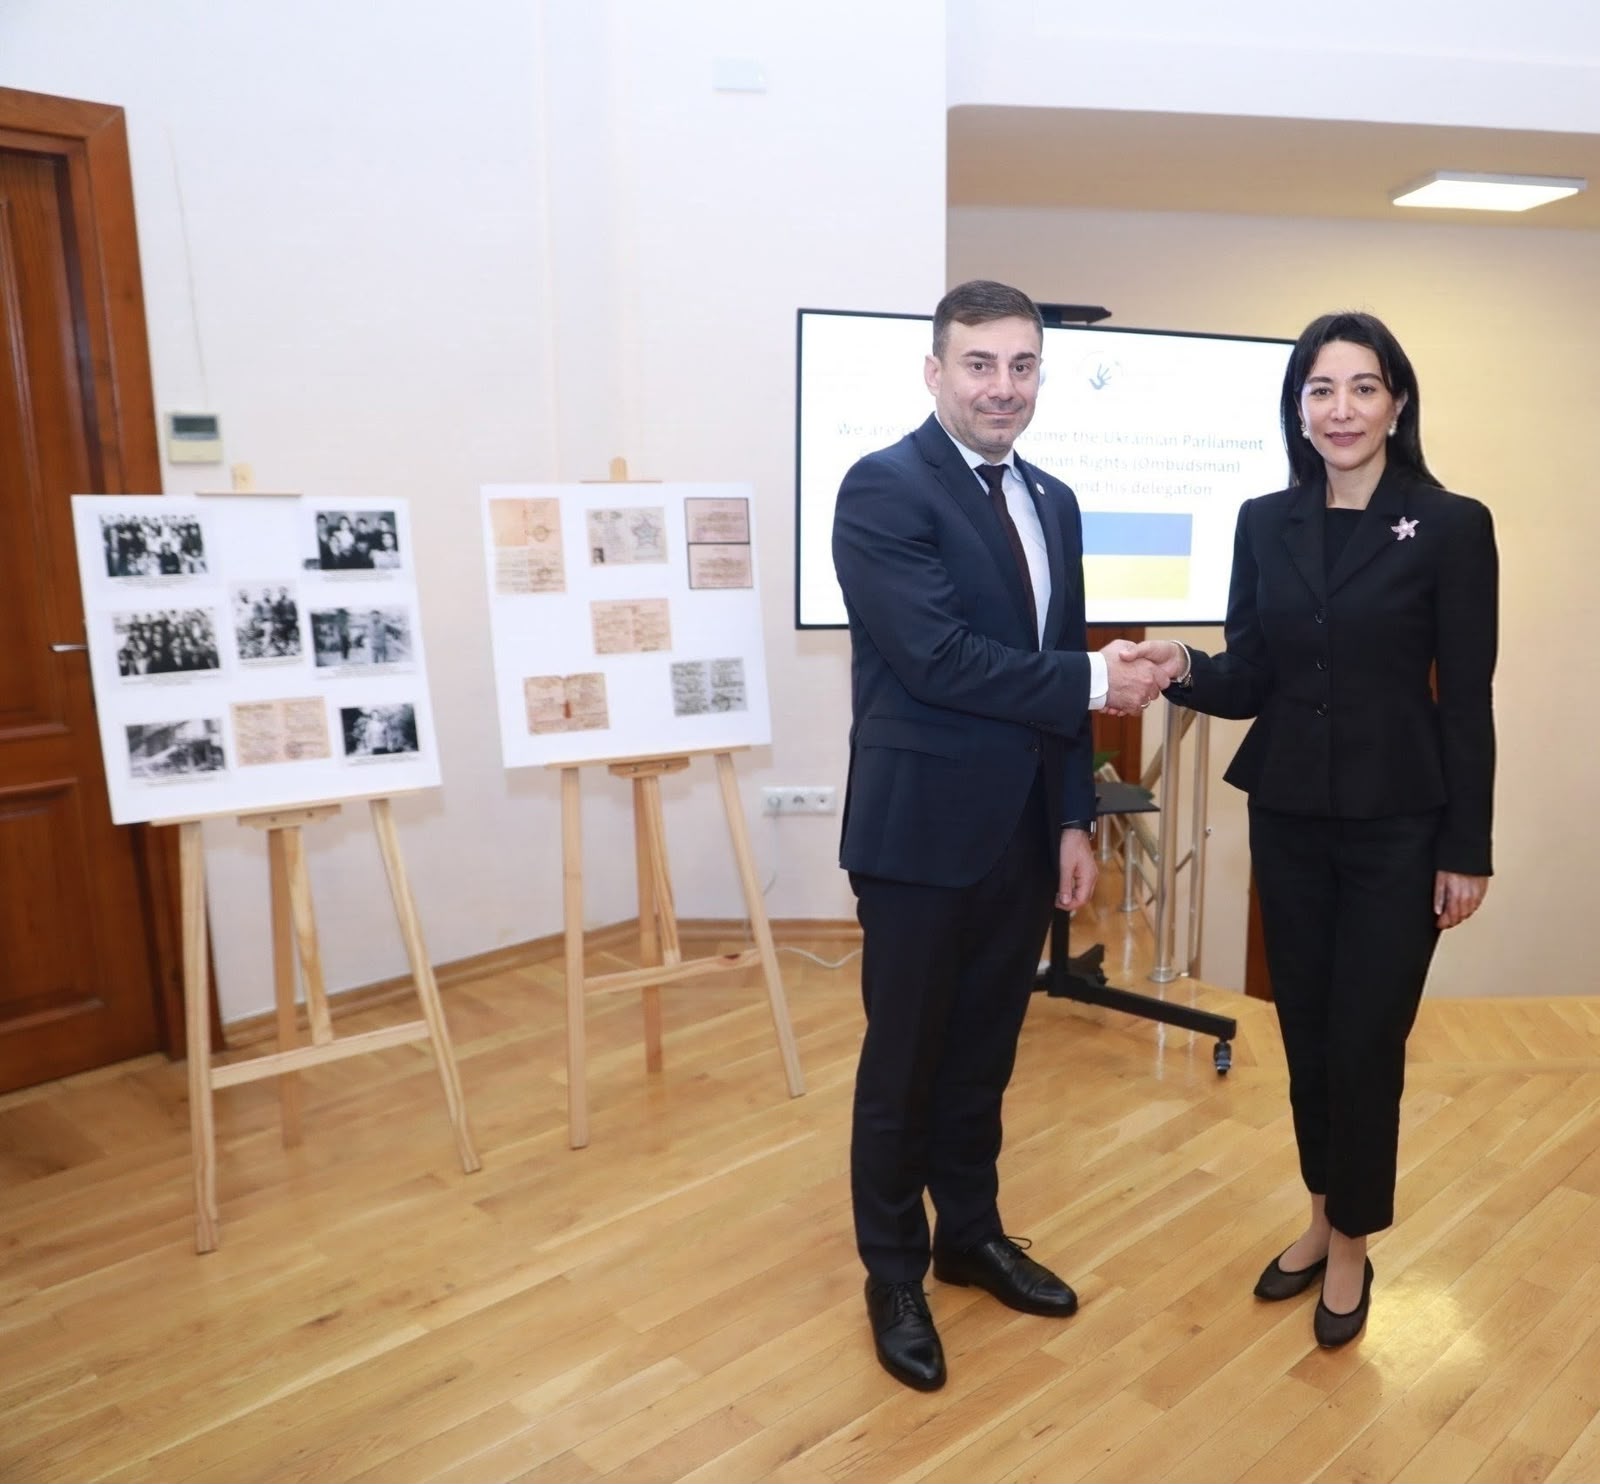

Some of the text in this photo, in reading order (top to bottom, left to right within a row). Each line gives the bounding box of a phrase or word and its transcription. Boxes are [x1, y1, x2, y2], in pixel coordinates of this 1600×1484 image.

[837, 423, 866, 435] We
[1072, 430, 1099, 443] the
[1104, 431, 1178, 447] Ukrainian
[1183, 433, 1264, 451] Parliament
[1080, 455, 1128, 473] Rights
[1132, 457, 1241, 474] (Ombudsman)
[1104, 480, 1128, 494] his
[1131, 480, 1213, 500] delegation
